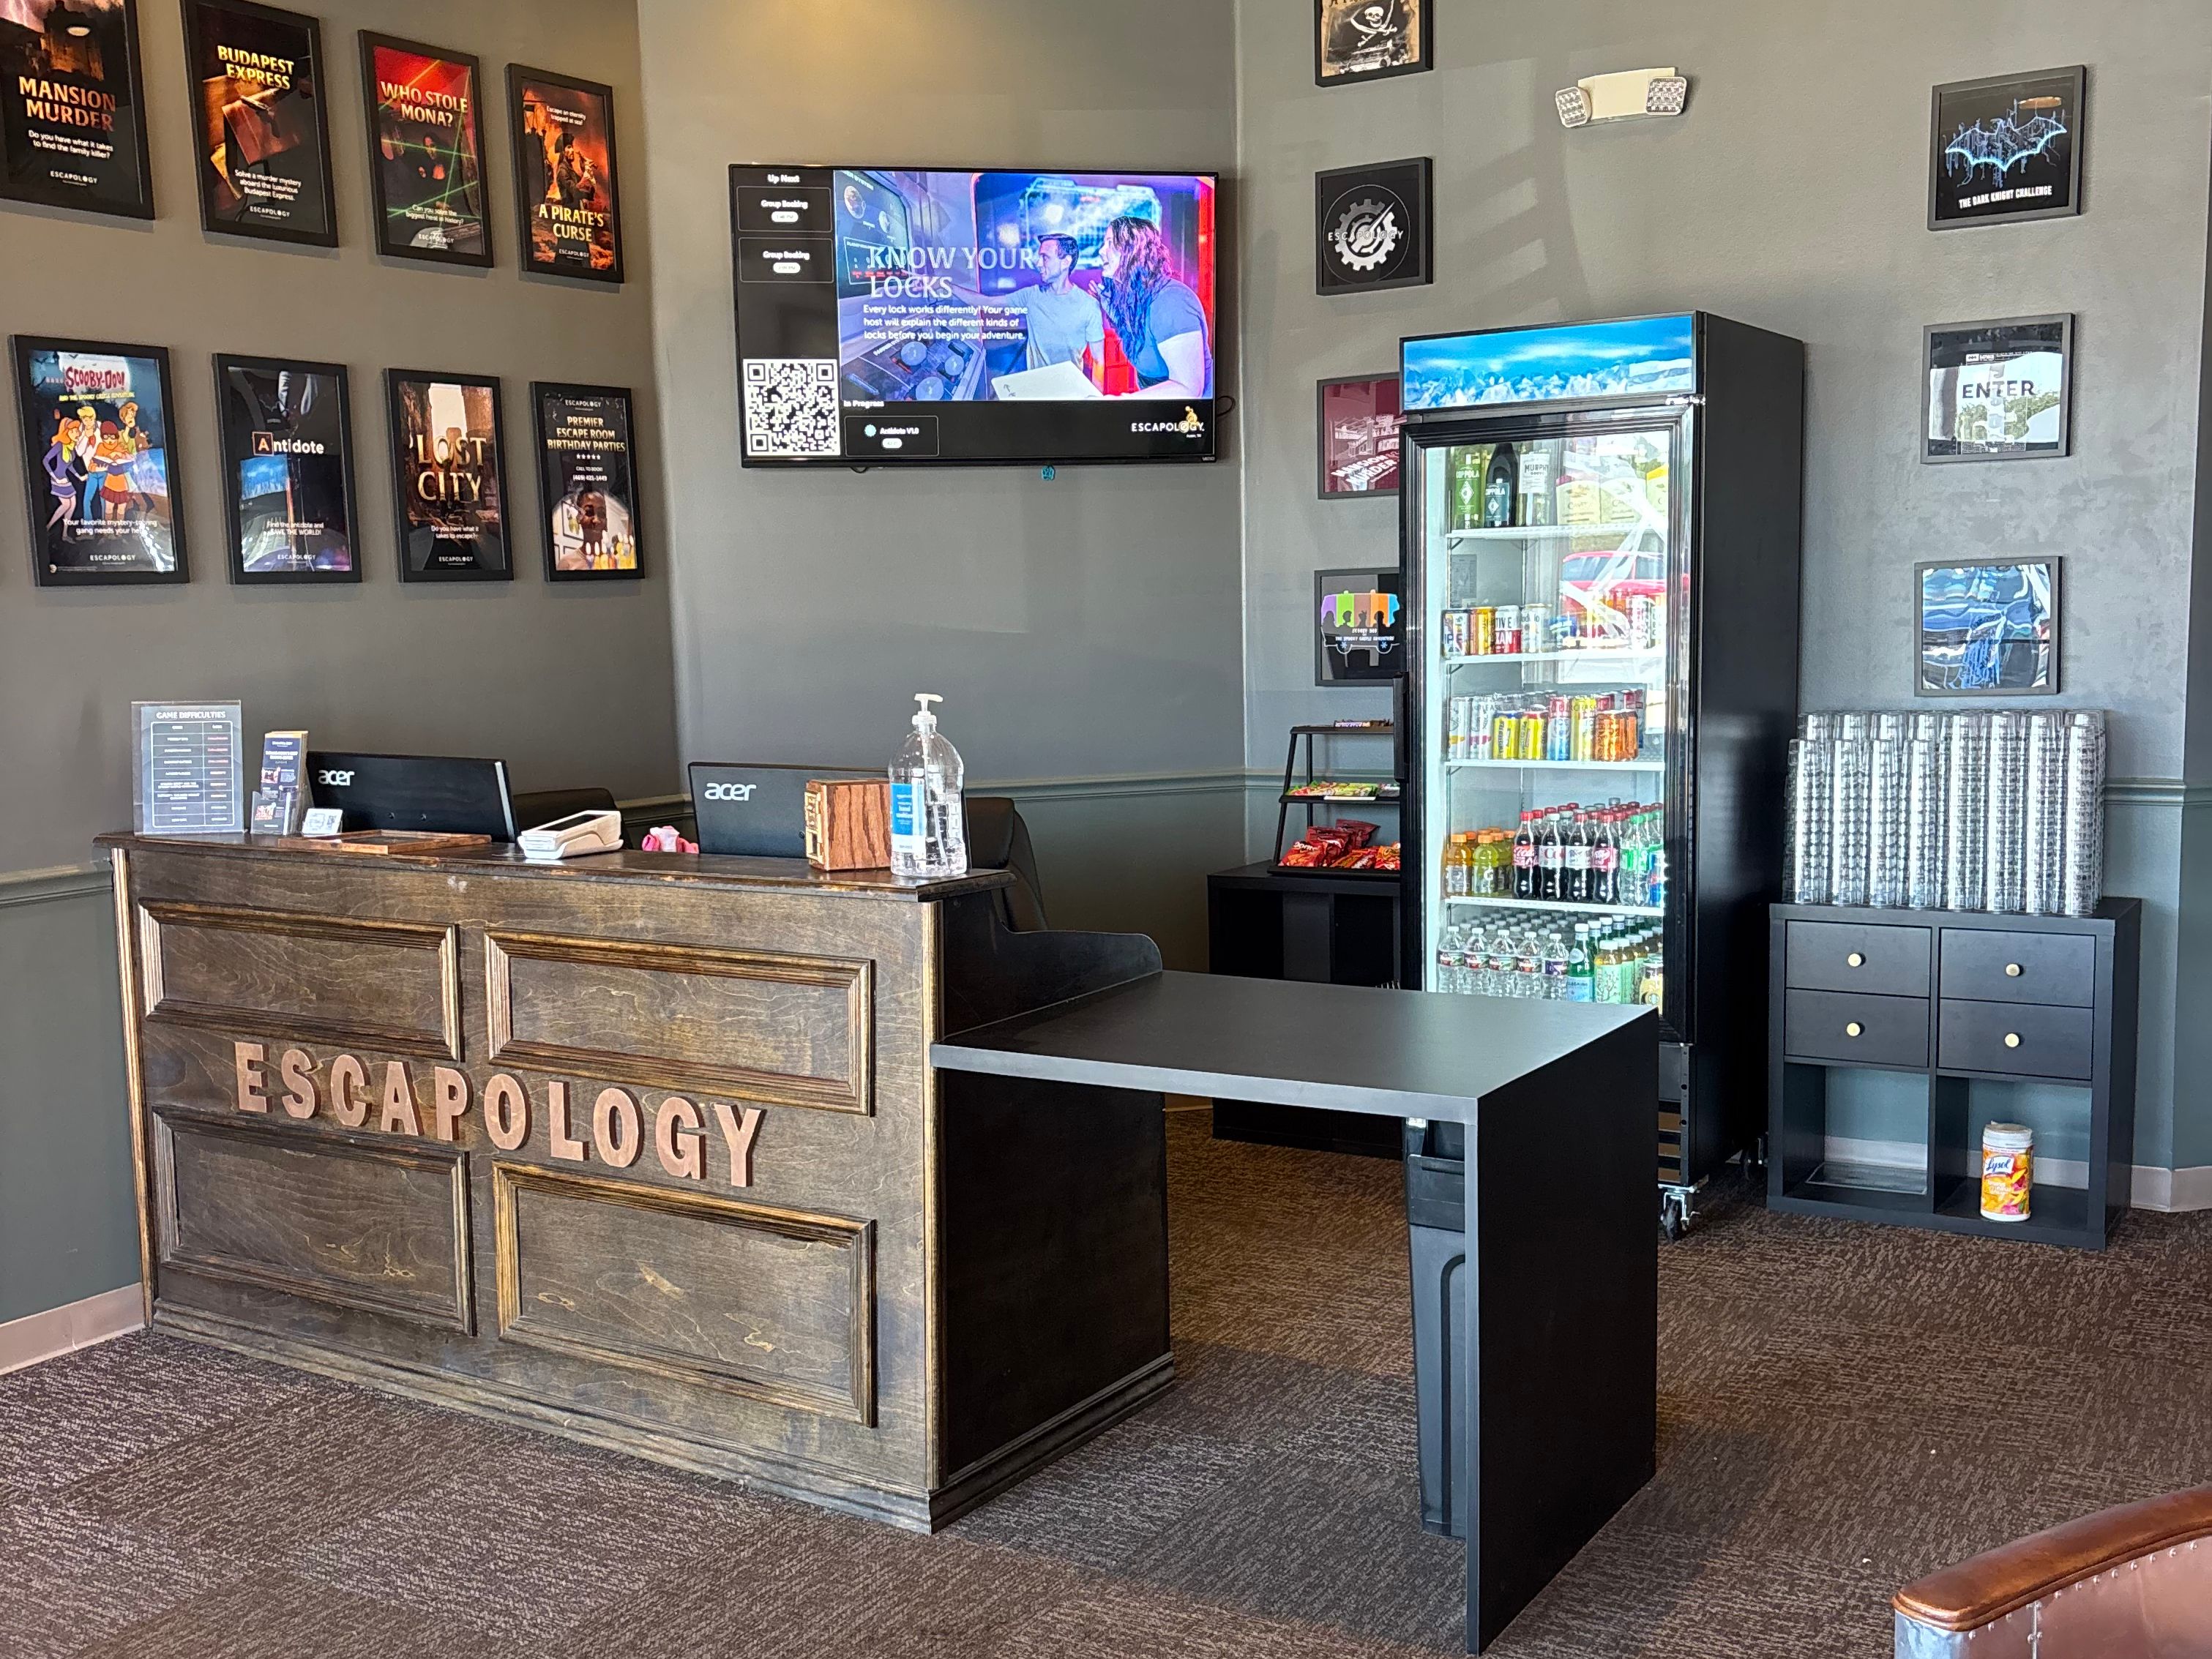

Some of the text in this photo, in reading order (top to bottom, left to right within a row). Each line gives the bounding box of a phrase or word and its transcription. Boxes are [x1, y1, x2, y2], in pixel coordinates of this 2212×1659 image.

[217, 45, 294, 75] BUDAPEST
[226, 63, 290, 90] EXPRESS
[19, 76, 116, 112] MANSION
[380, 80, 468, 113] WHO STOLE
[26, 99, 114, 132] MURDER
[400, 103, 454, 128] MONA?
[28, 130, 39, 138] Do
[55, 135, 71, 143] have
[72, 138, 89, 146] what
[96, 143, 113, 152] takes
[42, 141, 56, 150] find
[57, 143, 69, 151] the
[50, 171, 97, 184] ESCAPOLOGY
[767, 174, 800, 184] Up Next
[761, 200, 808, 210] Group Booking
[1959, 186, 2052, 209] THE DARK KNIGHT CHALLENGE
[250, 206, 291, 217] ESCAPOLOGY
[539, 203, 604, 228] A PIRATE'S
[553, 222, 592, 242] CURSE
[558, 248, 589, 258] ESCAPOLOGY
[763, 250, 810, 261] Group Booking
[869, 247, 1036, 270] KNOW YOUR
[870, 275, 953, 299] LOCKS
[863, 304, 886, 315] Every
[888, 304, 907, 314] lock
[908, 305, 934, 314] works
[982, 305, 1003, 314] Your
[1004, 307, 1028, 316] game
[864, 318, 1019, 329] host will explain the different kinds of
[864, 331, 1025, 342] locks before you begin your adventure.
[65, 366, 125, 390] SCOOBY-DOO!
[1962, 380, 2038, 399] ENTER
[565, 399, 602, 408] ESCAPOLOGY
[567, 416, 604, 427] PREMIER
[556, 427, 615, 440] ESCAPE ROOM
[258, 437, 324, 454] Antidote
[416, 434, 487, 466] LOST
[547, 439, 626, 452] BIRTHDAY PARTIES
[418, 471, 482, 503] CITY
[62, 518, 79, 526] Your
[156, 711, 178, 719] GAME
[318, 769, 355, 787] acer
[704, 782, 757, 801] acer
[233, 1041, 765, 1188] ESCAPOLOGY
[1986, 1158, 2011, 1173] Lysol
